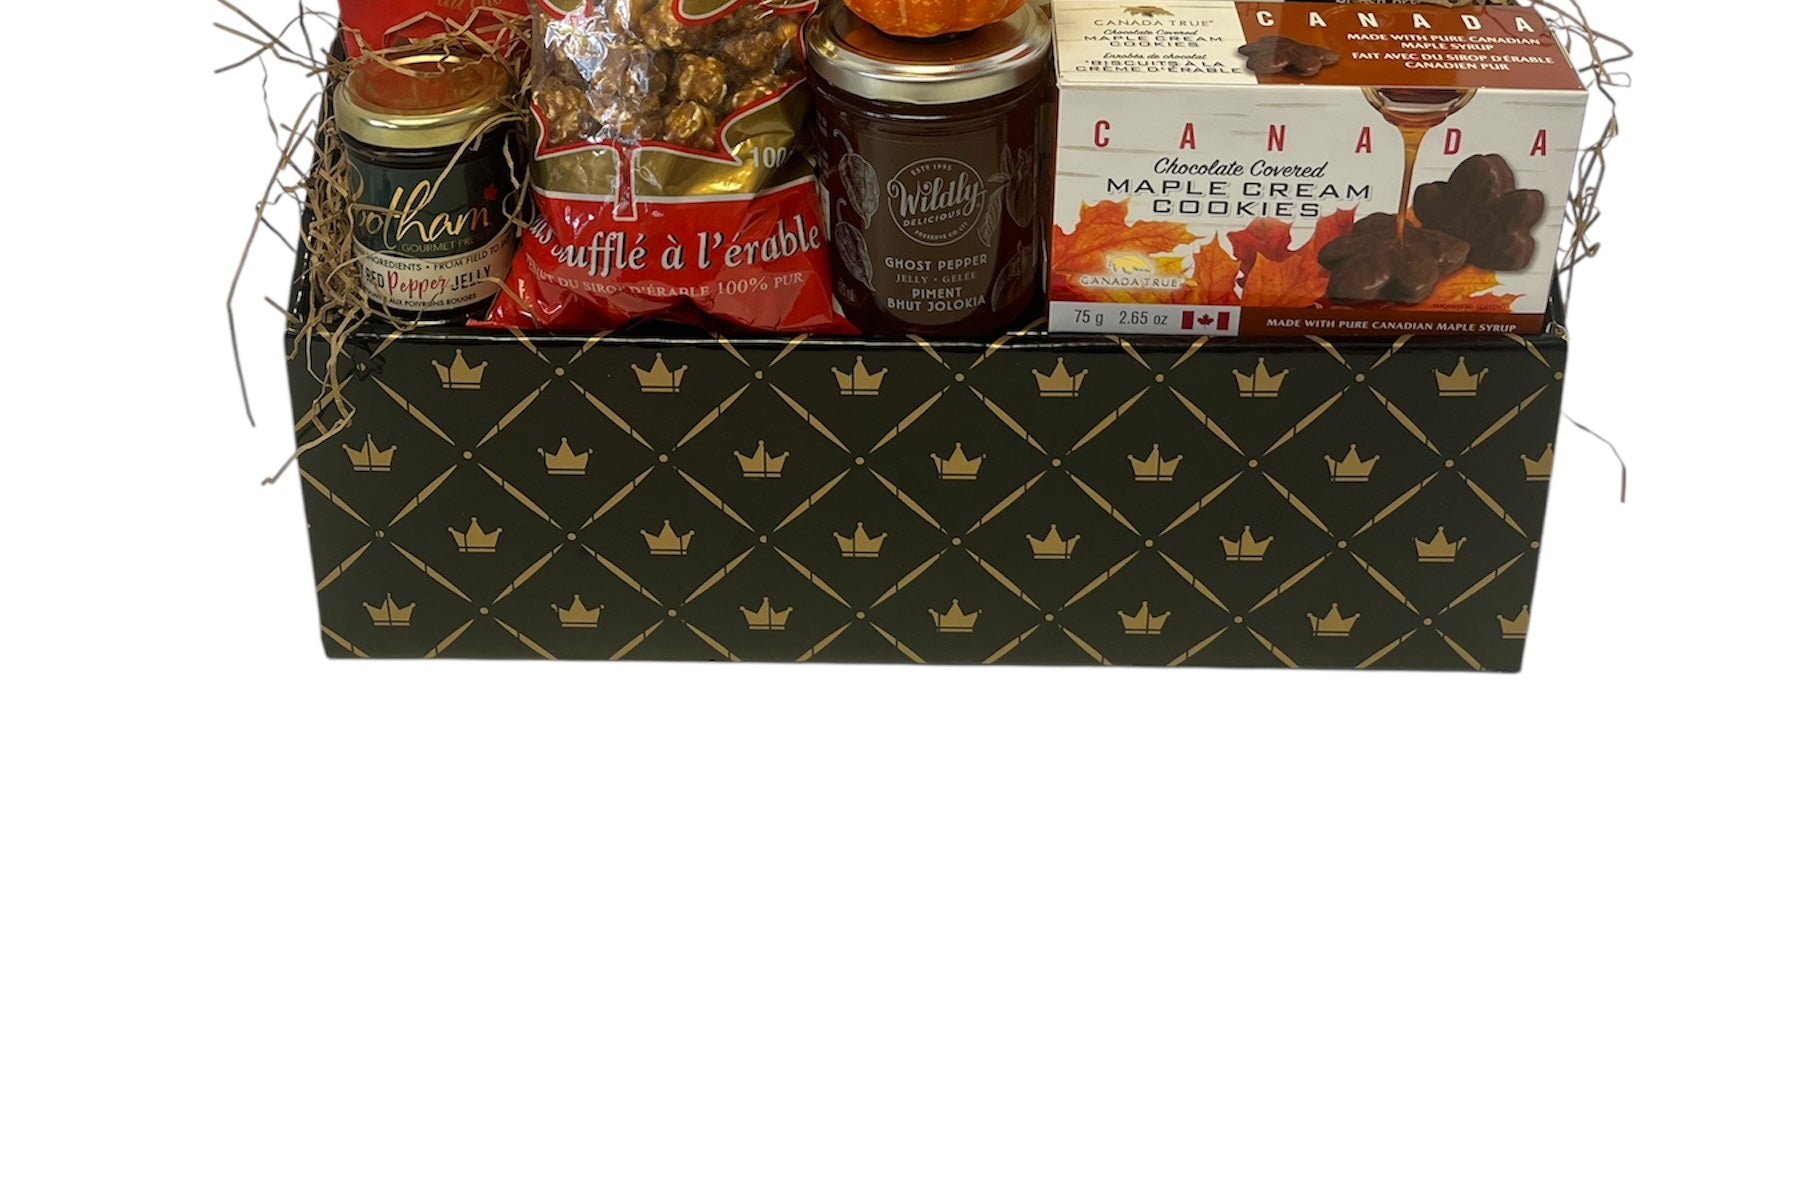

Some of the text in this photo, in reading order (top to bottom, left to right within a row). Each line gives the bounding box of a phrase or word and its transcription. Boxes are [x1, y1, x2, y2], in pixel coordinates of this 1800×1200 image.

[1094, 19, 1164, 27] CANADA
[1347, 33, 1541, 45] MADE WITH PURE CANADIAN
[1401, 42, 1495, 51] MAPLE SYRUP
[1352, 52, 1380, 60] FAIT
[1384, 52, 1420, 61] AVEC
[1421, 53, 1443, 61] DU
[1444, 53, 1488, 62] SIROP
[1405, 61, 1511, 71] CANADIEN PUR
[1154, 157, 1329, 179] Chocolate Covered
[887, 172, 988, 218] Wildly
[1106, 178, 1371, 199] MAPLE CREAM
[1152, 199, 1320, 217] COOKIES
[903, 209, 961, 227] DELICIOUS
[401, 241, 455, 253] GOURMET
[660, 233, 685, 270] à
[697, 213, 821, 270] l'érable
[434, 260, 464, 271] FROM
[884, 253, 988, 271] GHOST PEPPER
[388, 271, 450, 299] Pepper
[451, 265, 492, 291] JELLY
[558, 276, 579, 289] DU
[717, 276, 768, 296] 100%
[774, 272, 804, 289] PUR
[896, 273, 929, 284] JELLY
[1081, 276, 1140, 286] CANADA
[912, 287, 962, 299] PIMENT
[887, 295, 986, 312] BHUT JOLOKIA
[1074, 309, 1168, 326] 75 g 2.65 oz
[1266, 318, 1517, 333] MADE WITH PURE CANADIAN MAPLE SYRUP
